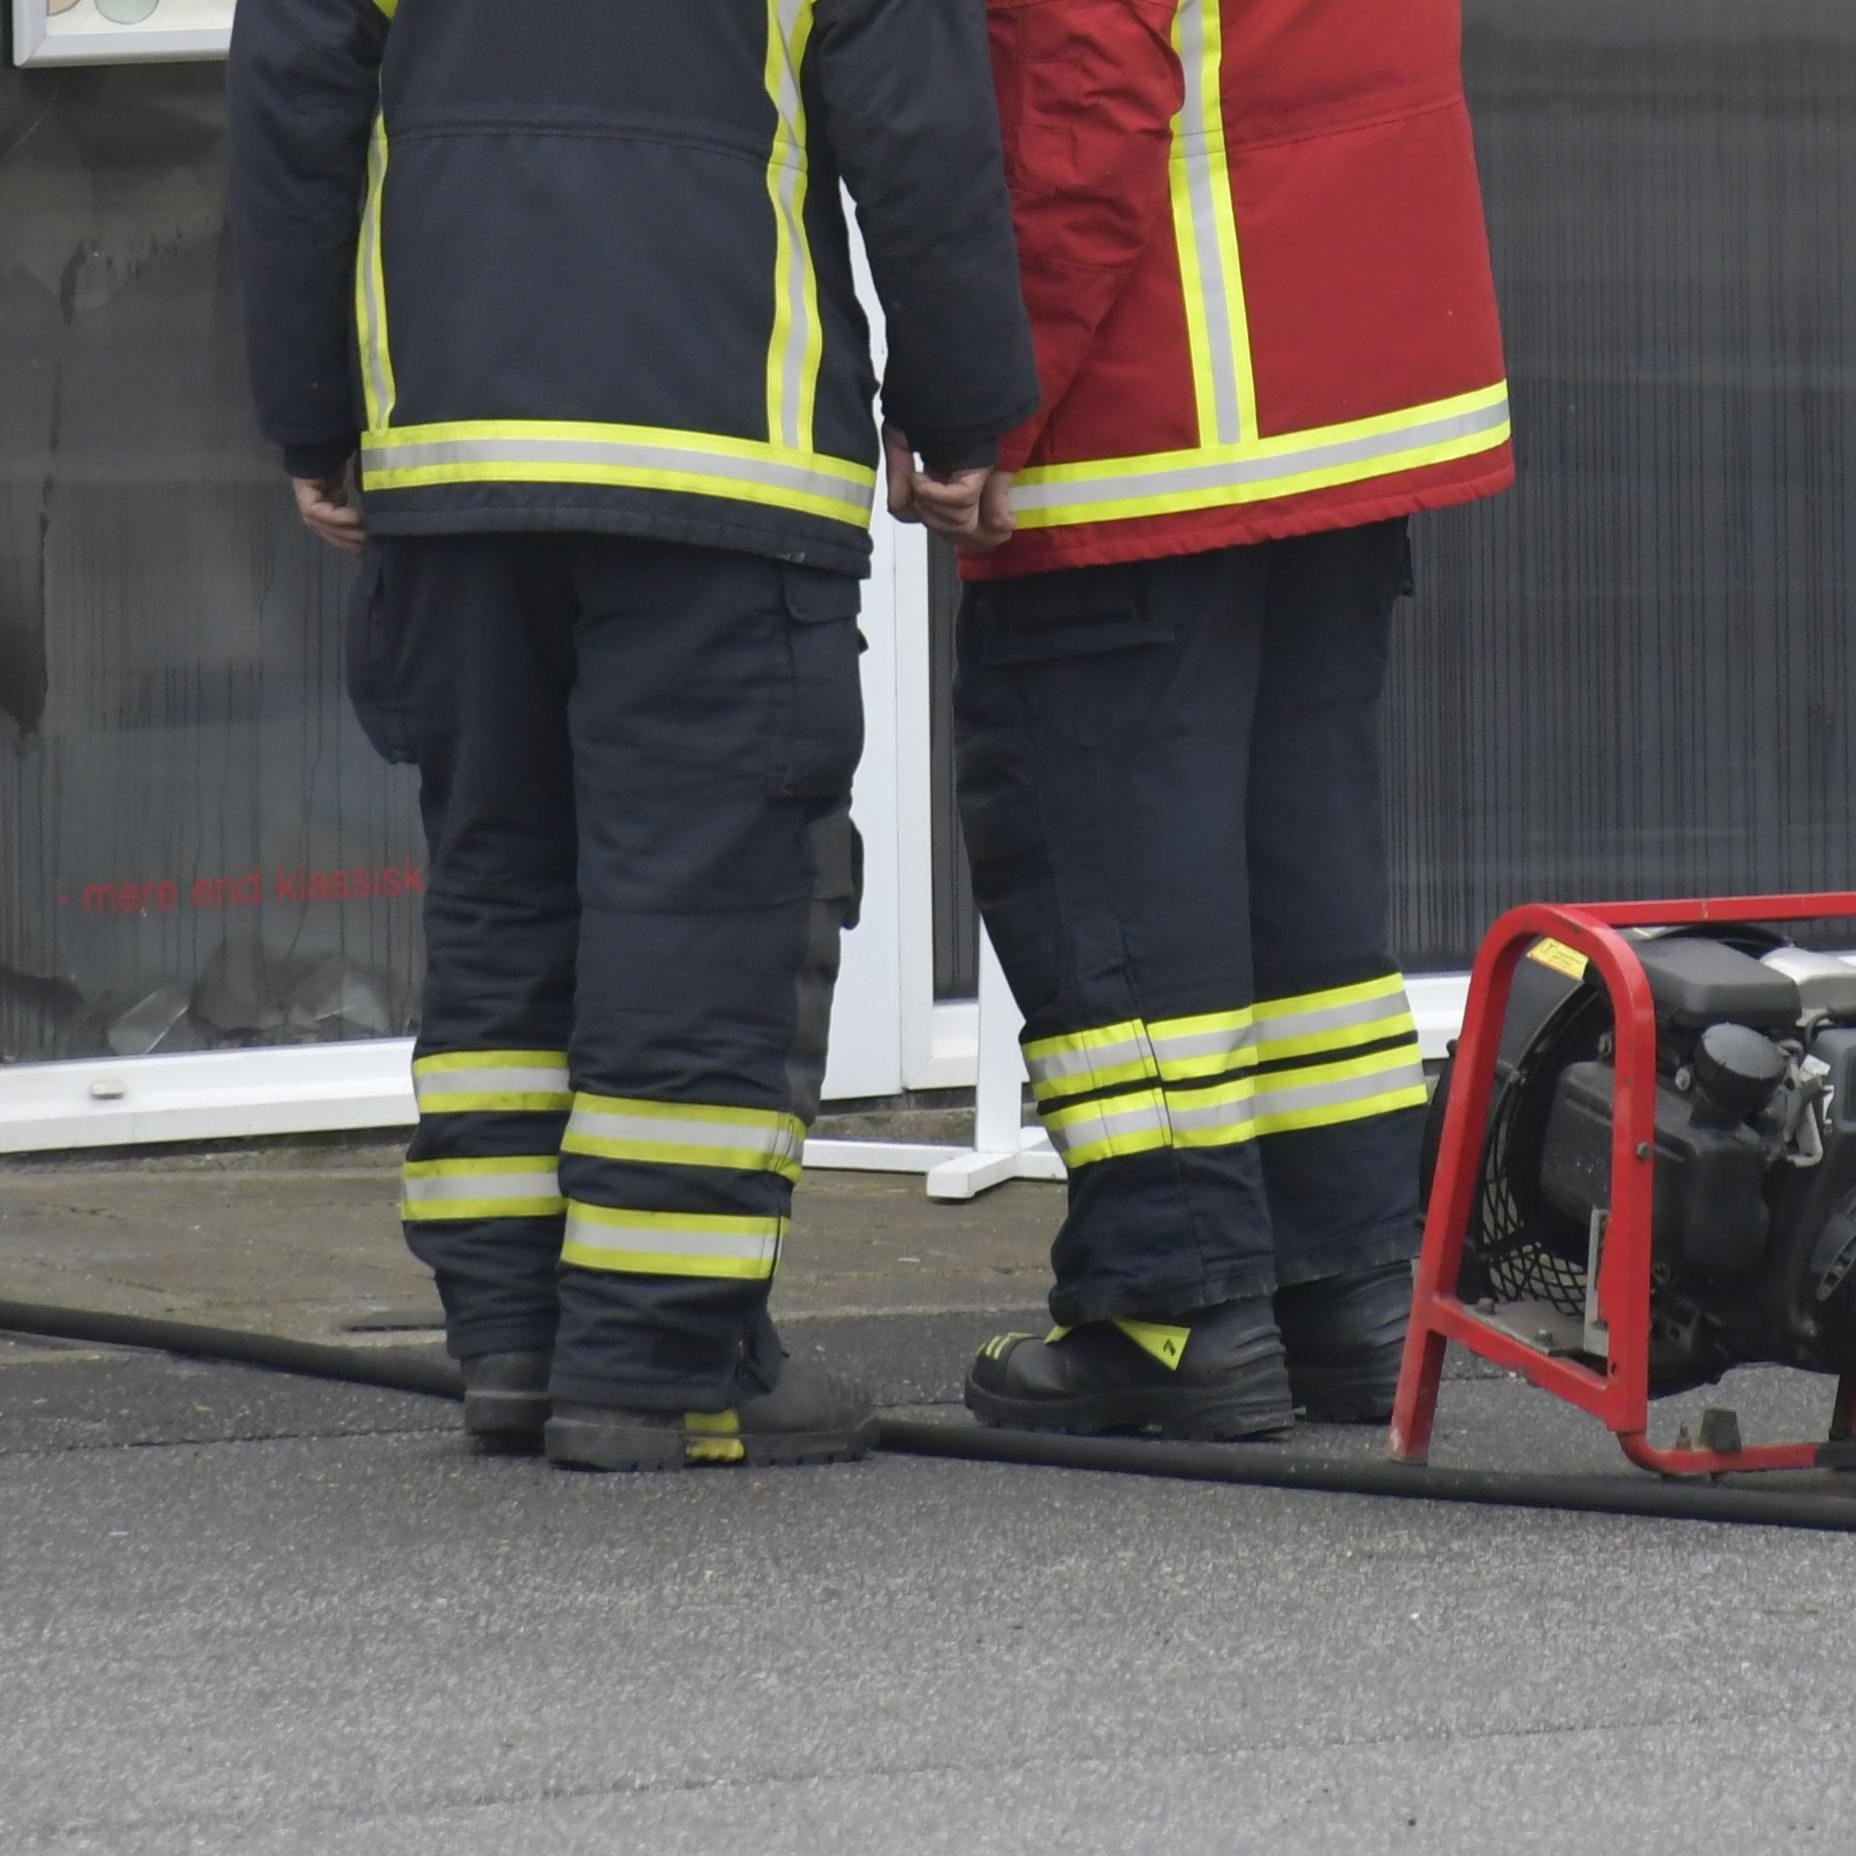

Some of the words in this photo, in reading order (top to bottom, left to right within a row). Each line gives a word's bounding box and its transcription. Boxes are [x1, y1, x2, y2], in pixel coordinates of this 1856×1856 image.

[81, 878, 179, 914] mere
[191, 866, 263, 910] end
[276, 850, 425, 904] klassisk
